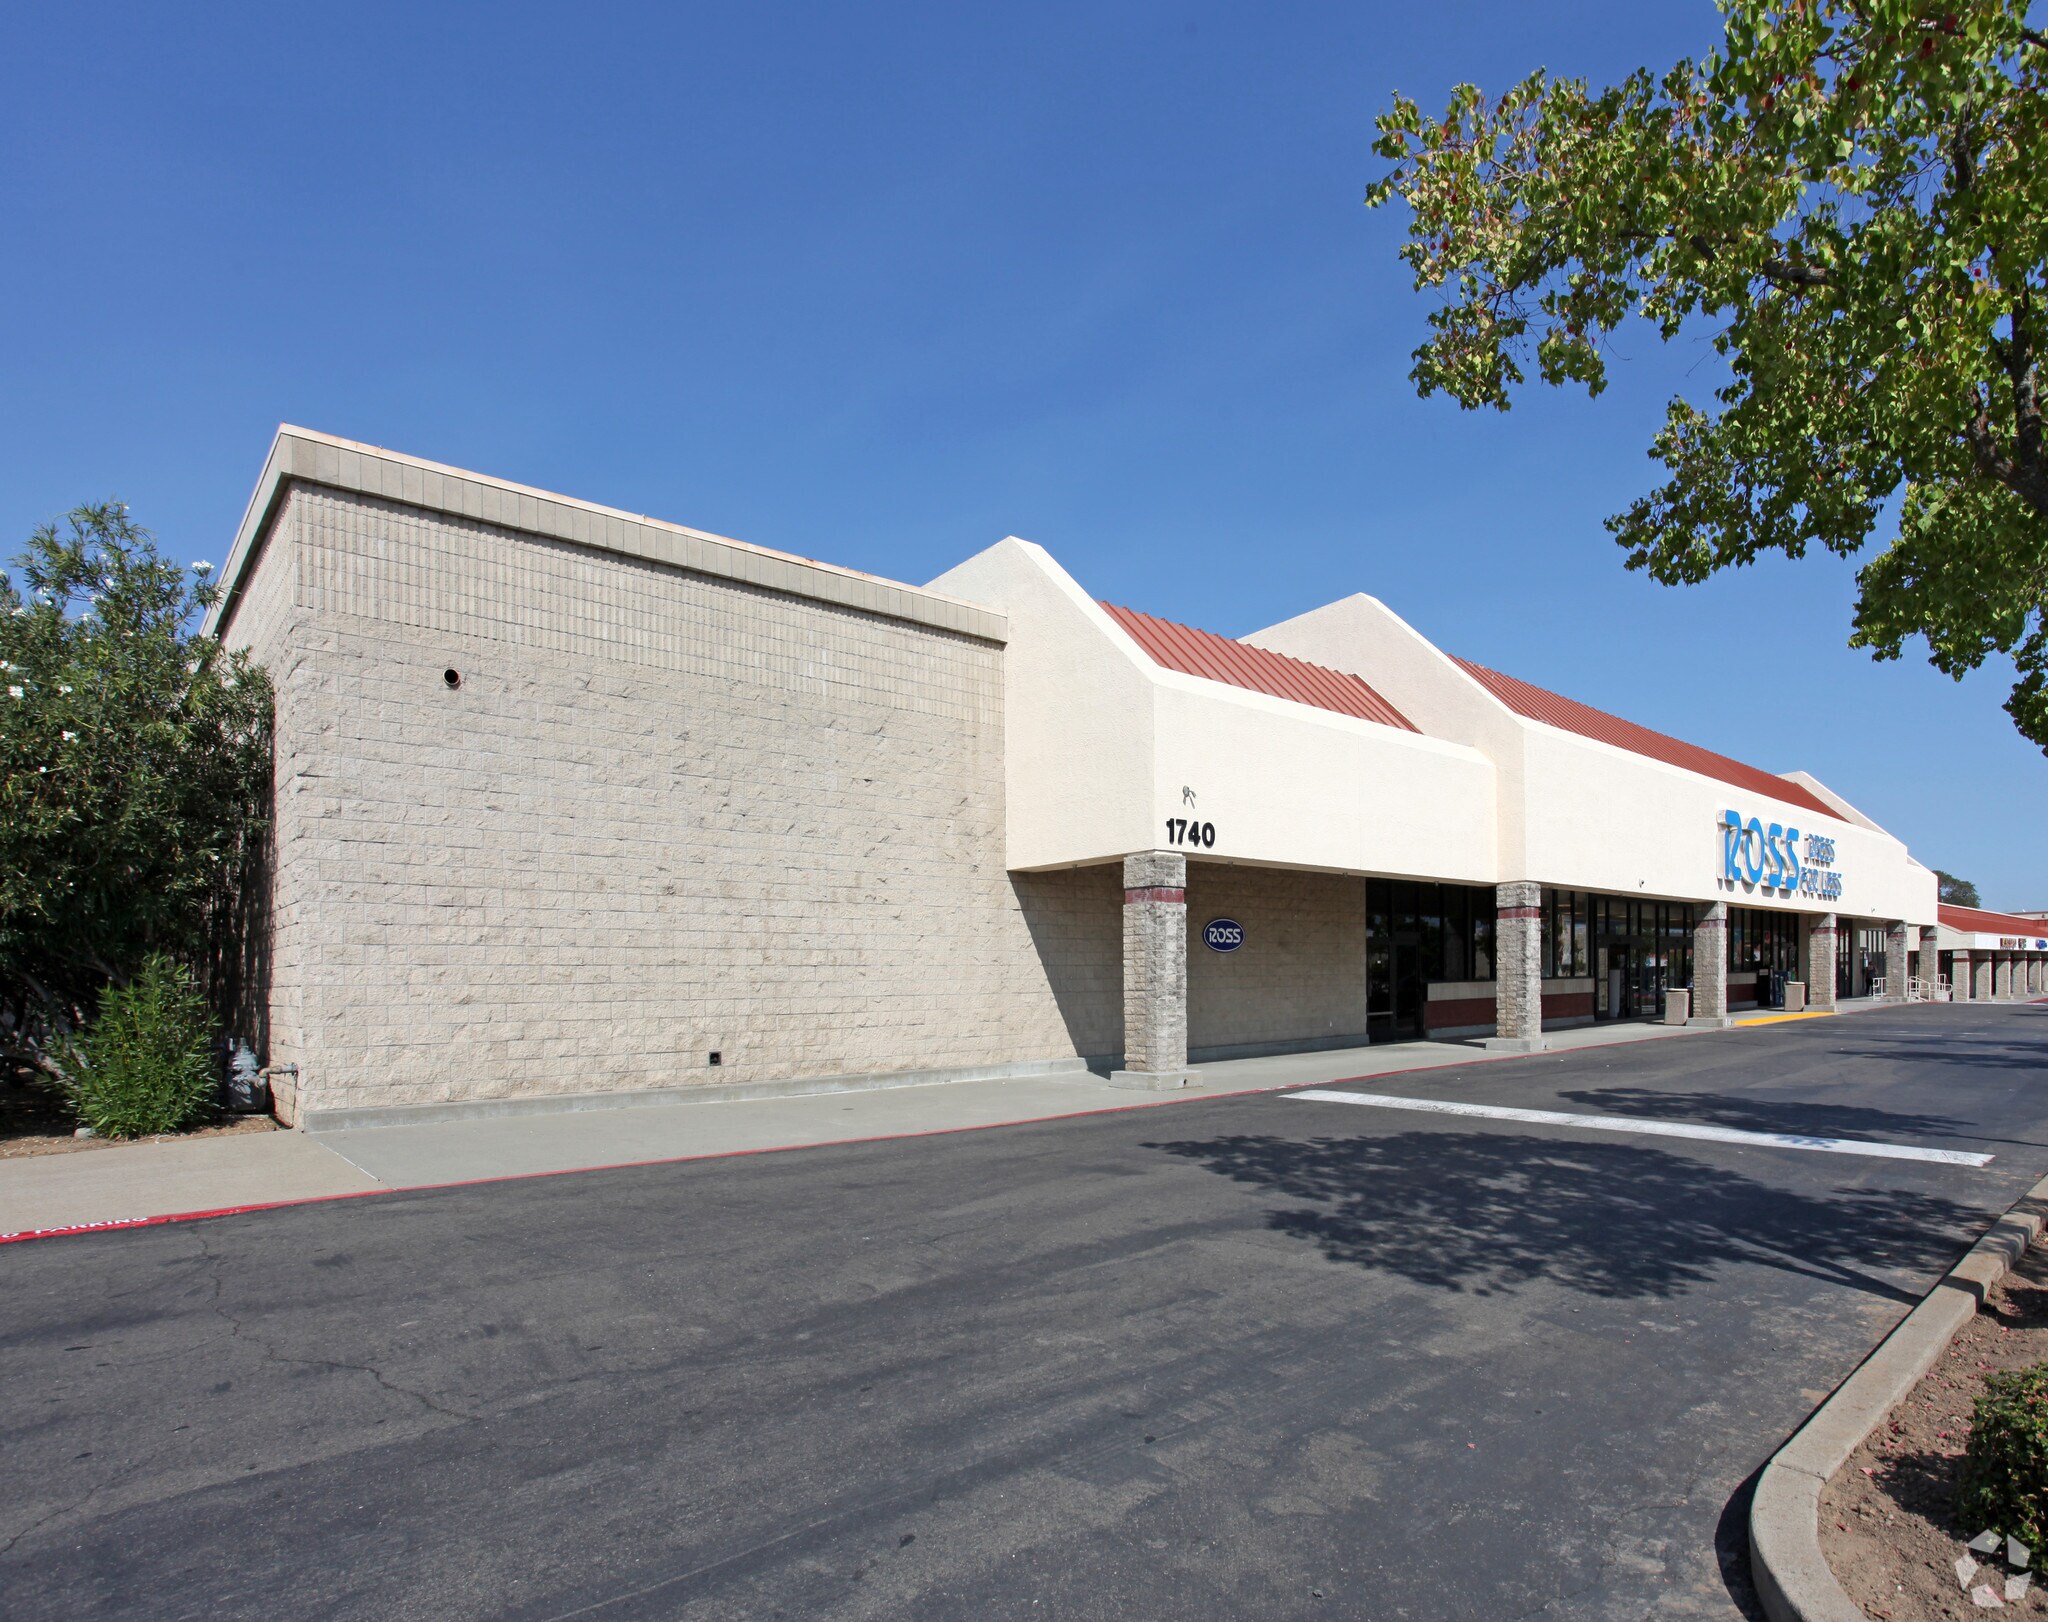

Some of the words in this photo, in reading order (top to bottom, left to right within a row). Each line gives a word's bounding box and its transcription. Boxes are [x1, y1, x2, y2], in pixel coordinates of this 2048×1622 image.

[1166, 818, 1216, 848] 1740
[1717, 809, 1799, 890] ROSS
[1208, 927, 1241, 944] ROSS
